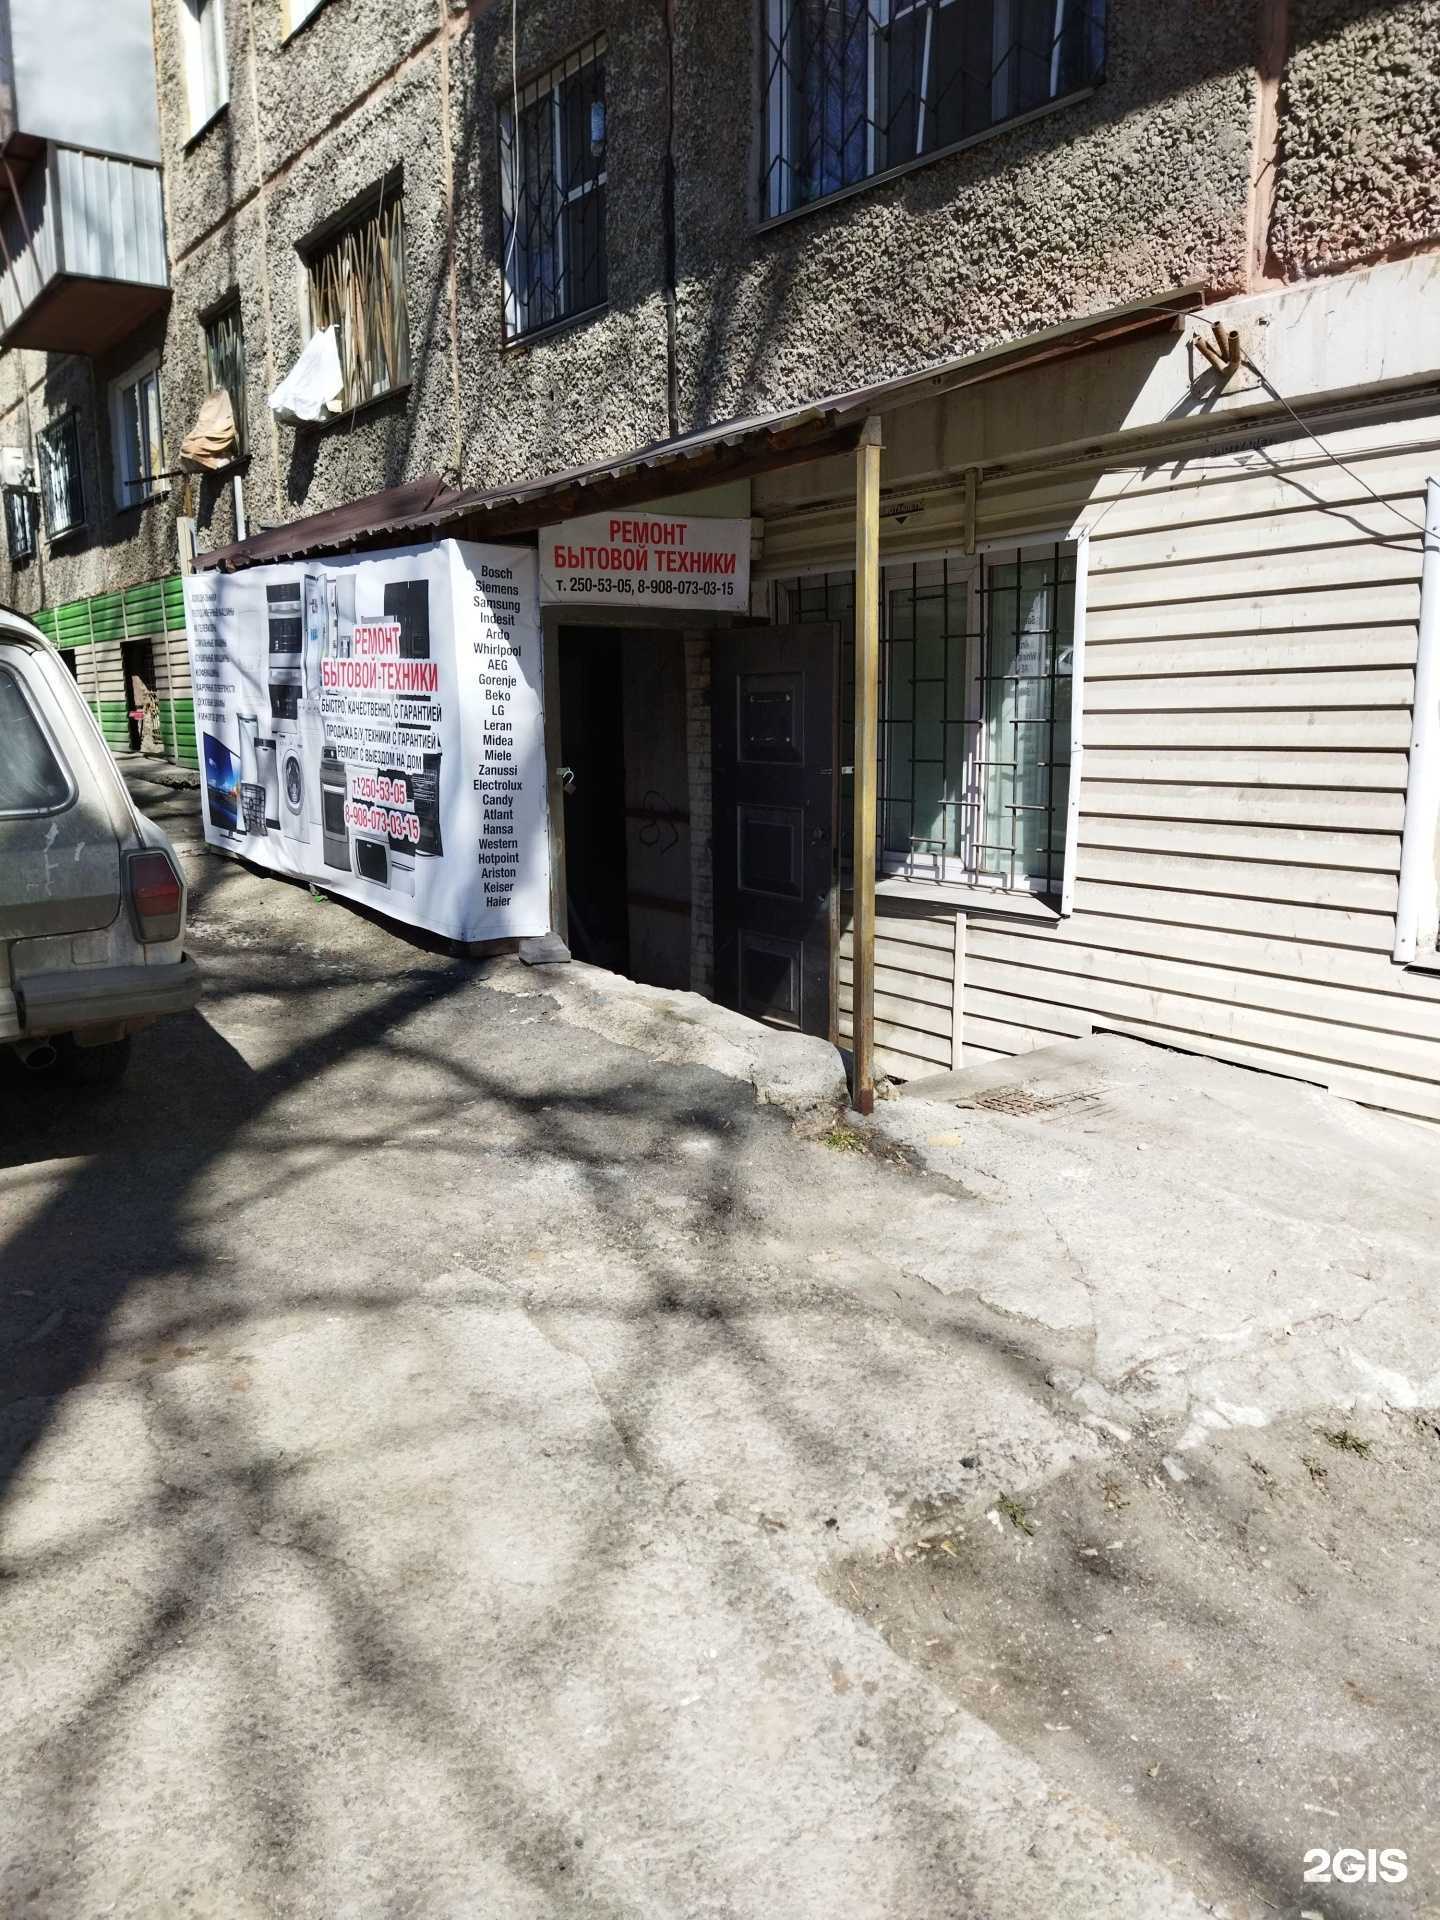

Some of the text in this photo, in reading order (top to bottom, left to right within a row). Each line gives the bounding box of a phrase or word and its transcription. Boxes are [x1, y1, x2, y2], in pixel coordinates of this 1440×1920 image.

[610, 520, 687, 545] РЕМОНТ
[554, 544, 736, 574] БЫТОВОЙ ТЕХНИКИ
[481, 565, 513, 579] Bosch
[475, 580, 519, 595] Siemens
[556, 578, 734, 595] т. 250-53-05, 8-908-073-03-15
[473, 596, 520, 613] Samsung
[480, 612, 515, 626] Indesit
[355, 627, 399, 654] РЕМОНТ
[486, 628, 510, 640] Ardo
[473, 642, 522, 657] Whirlpool
[488, 659, 508, 670] AEG
[323, 657, 438, 692] БЫТОВОЙ ТЕХНИКИ
[478, 674, 517, 688] Gorenje
[485, 689, 511, 701] Beko
[321, 699, 442, 722] БЫСТРО, КАЧЕСТВЕННО, С ГАРАНТИЕЙ
[492, 705, 505, 715] LG
[484, 720, 512, 731] Leran
[326, 724, 352, 739] ПРОДАЖА
[365, 728, 391, 744] ТЕХНИКИ
[392, 732, 397, 745] С
[398, 732, 436, 749] ГАРАНТИЕЙ
[483, 734, 513, 746] Midea
[337, 745, 422, 770] РЕМОНТ С ВЫЕЗДОМ НА ДОМ
[484, 749, 512, 760] Miele
[478, 764, 518, 776] Zanussi
[362, 777, 406, 804] 250-53-05
[473, 779, 523, 791] Electrolux
[482, 794, 514, 807] Candy
[345, 804, 419, 839] 8-908-073-03-15
[483, 809, 514, 820] Atlant
[483, 823, 513, 835] Hansa
[478, 839, 518, 849] Western
[478, 852, 520, 866] Hotpoint
[481, 867, 516, 879] Ariston
[486, 896, 511, 907] Haier
